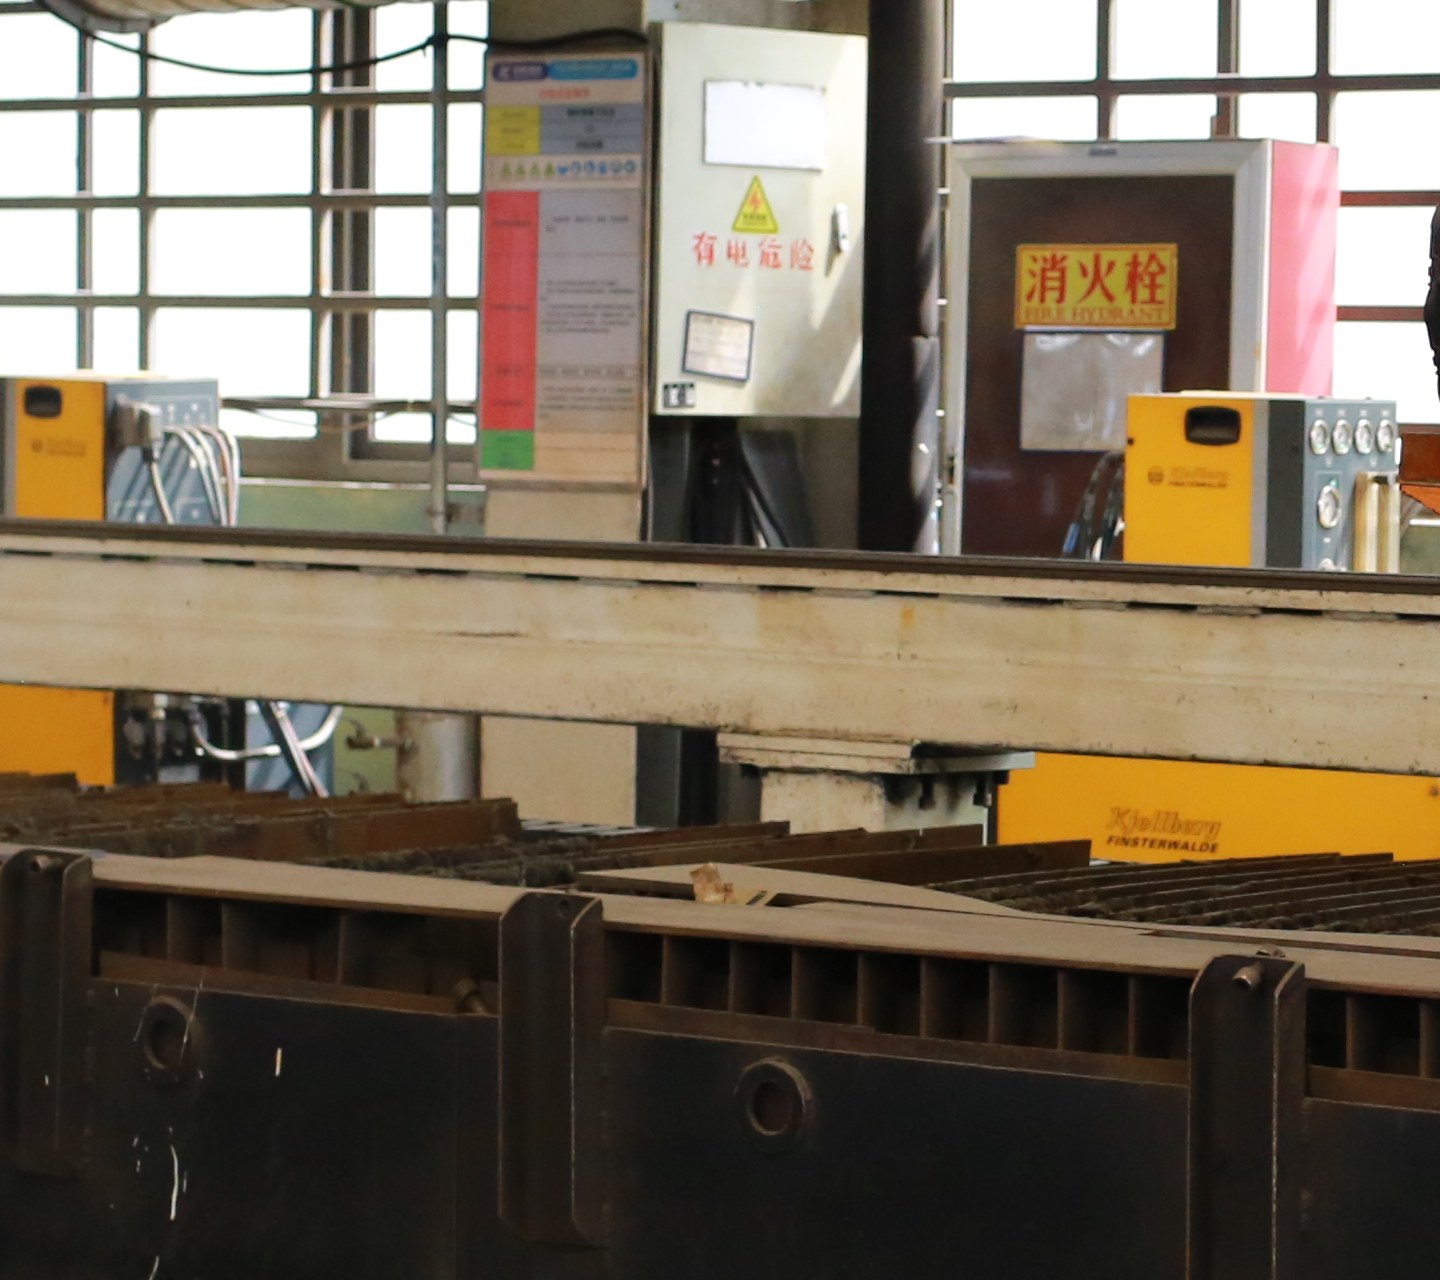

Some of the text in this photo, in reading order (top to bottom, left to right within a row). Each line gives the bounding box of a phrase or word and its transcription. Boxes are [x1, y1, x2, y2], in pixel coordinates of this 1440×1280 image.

[693, 231, 814, 271] 有电危险
[1026, 252, 1167, 305] 消火栓
[1073, 306, 1166, 320] HYDRANT
[1106, 807, 1222, 841] Kjellberg
[1106, 835, 1220, 854] FINSTERWALDE
